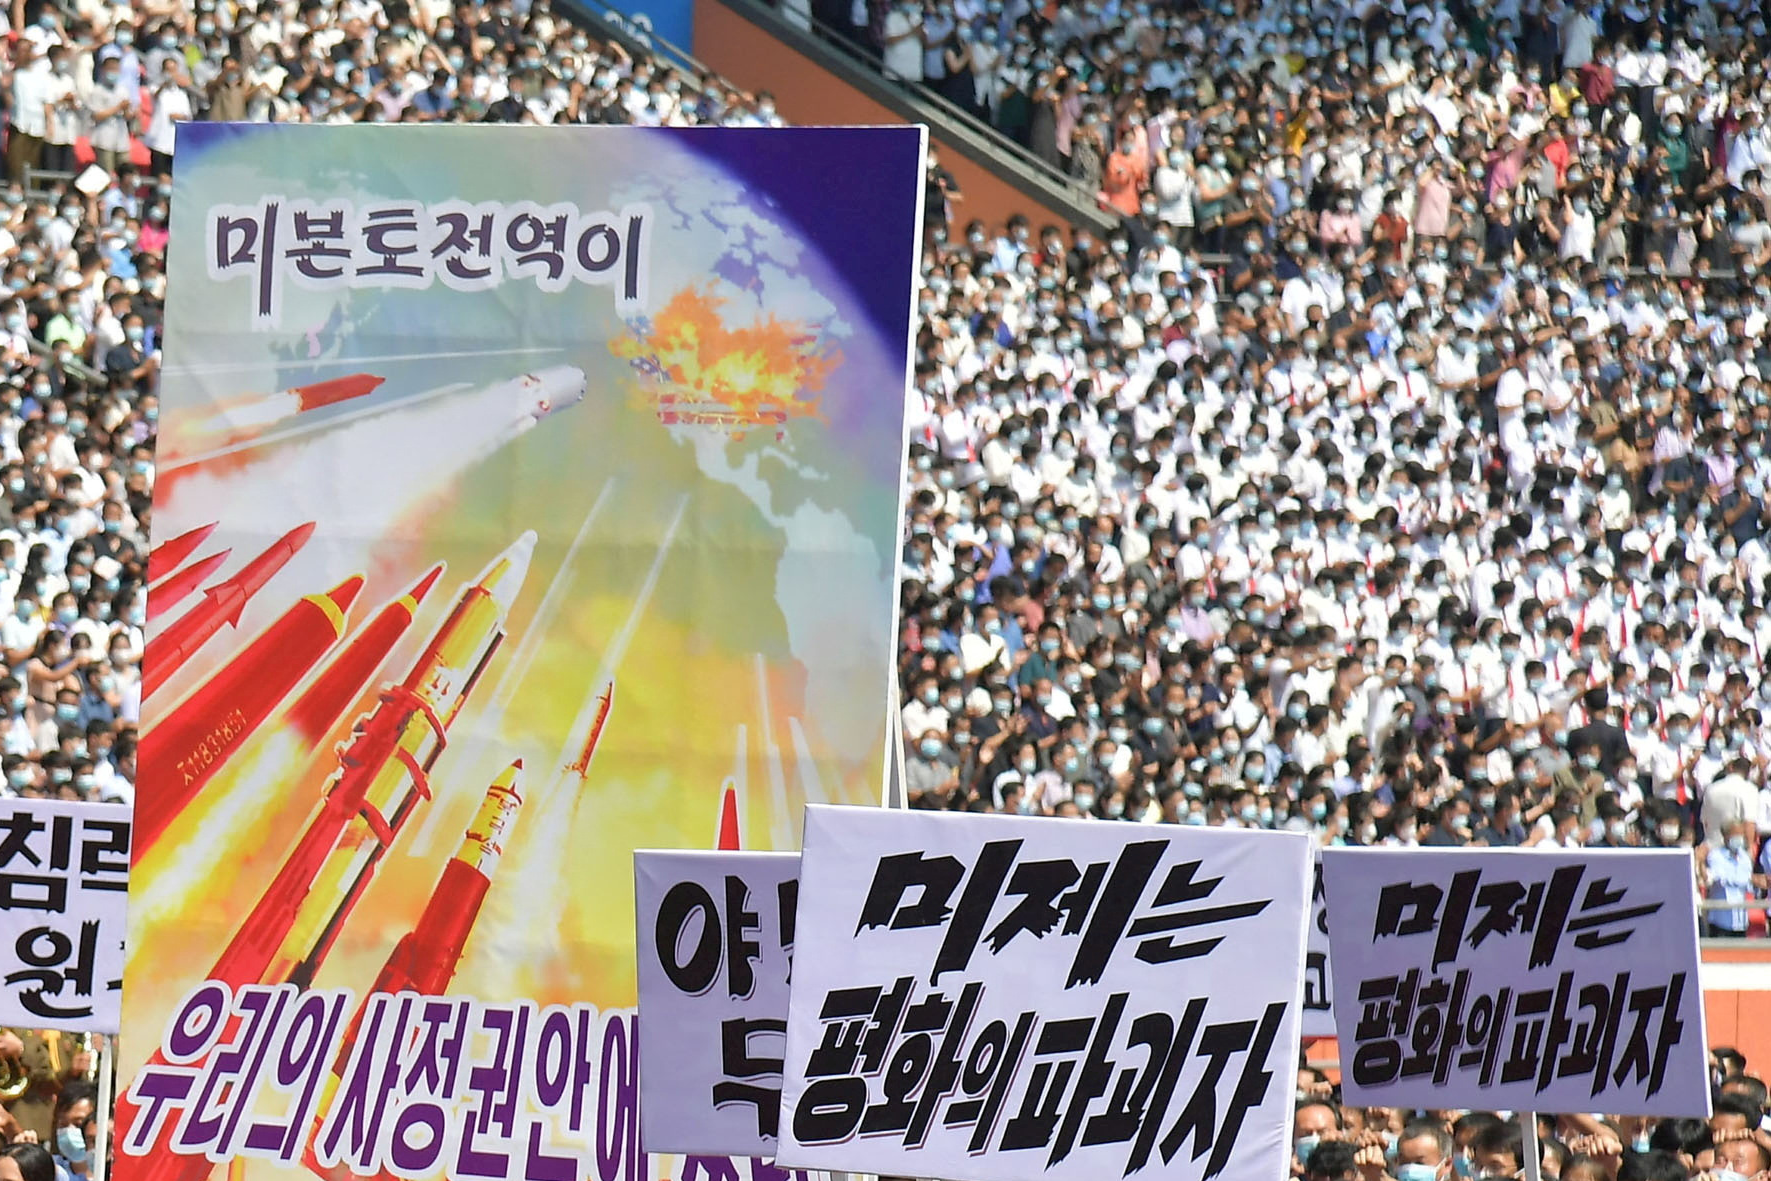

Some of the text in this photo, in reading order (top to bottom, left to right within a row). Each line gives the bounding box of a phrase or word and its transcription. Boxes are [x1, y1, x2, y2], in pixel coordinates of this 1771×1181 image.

[216, 203, 643, 316] 미본토전역이
[4, 919, 125, 1018] 원
[655, 875, 798, 999] 야
[854, 838, 1274, 990] 미제는
[1373, 864, 1664, 974] 미제는
[133, 986, 346, 1161] 우리의
